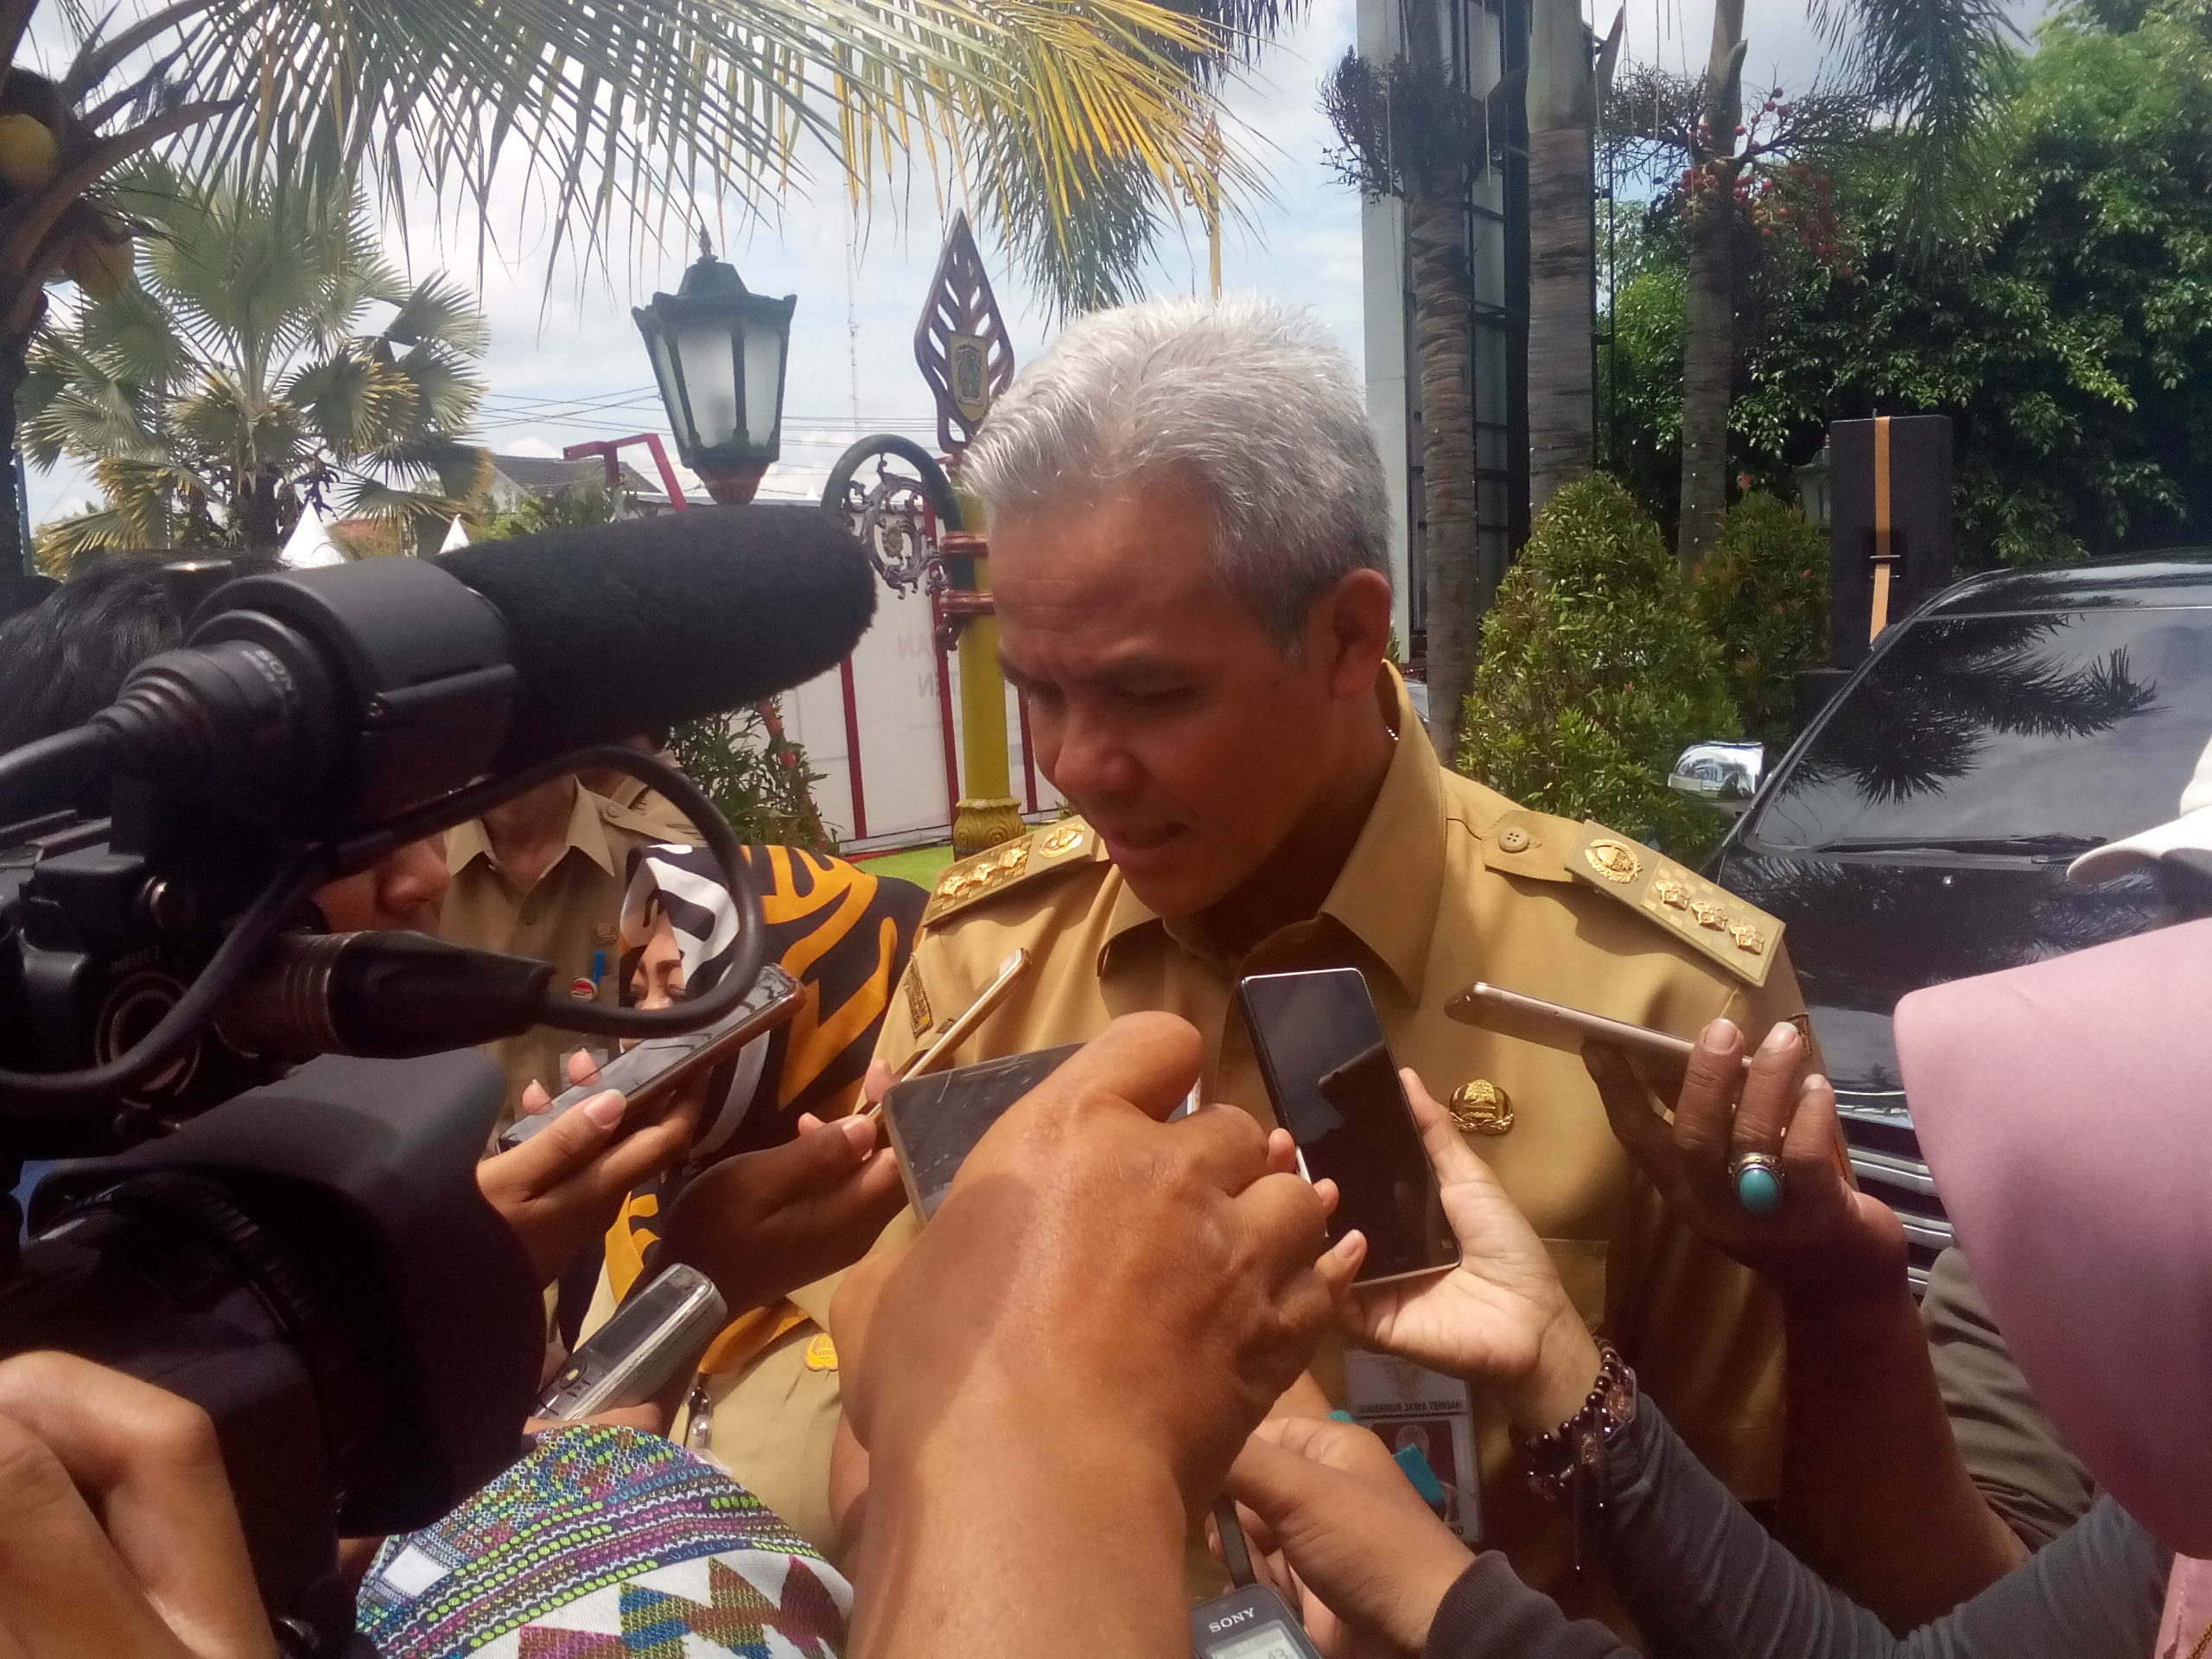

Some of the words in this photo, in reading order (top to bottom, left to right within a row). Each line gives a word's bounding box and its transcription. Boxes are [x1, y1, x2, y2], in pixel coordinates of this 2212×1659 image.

[1358, 1402, 1402, 1414] GUBERNUR
[1404, 1401, 1427, 1412] JAWA
[1429, 1399, 1462, 1411] TENGAH
[1208, 1607, 1255, 1633] SONY
